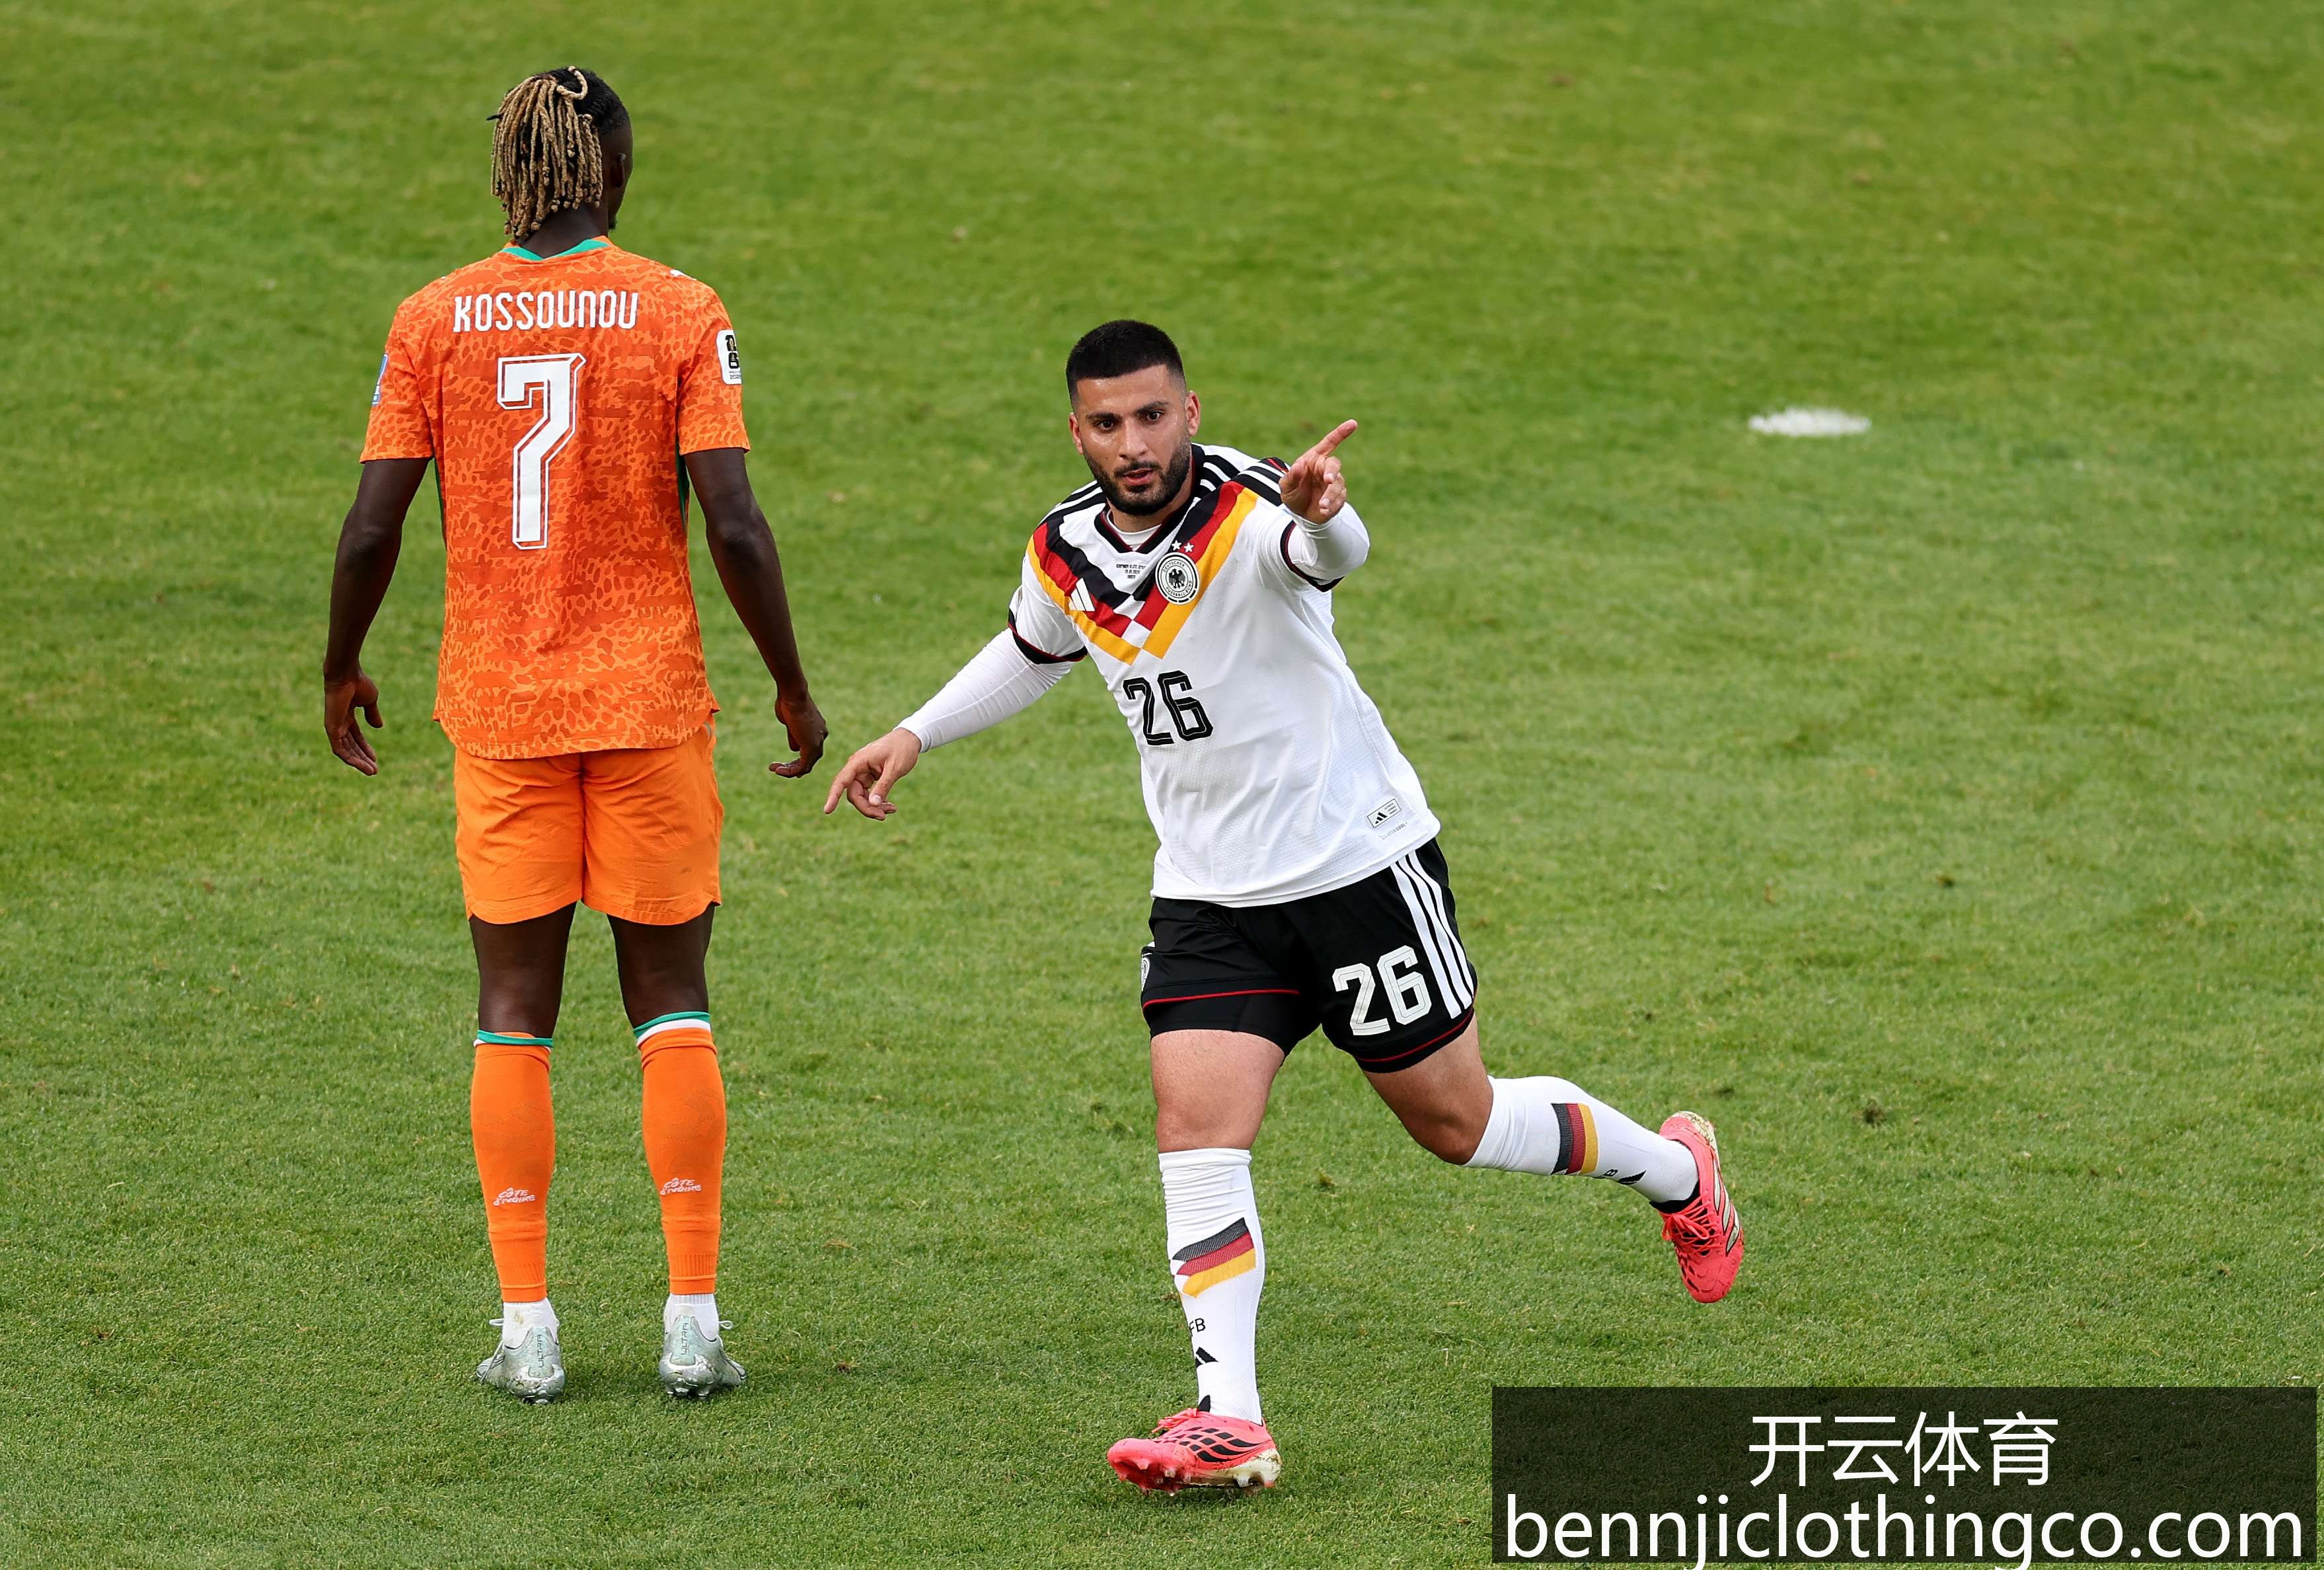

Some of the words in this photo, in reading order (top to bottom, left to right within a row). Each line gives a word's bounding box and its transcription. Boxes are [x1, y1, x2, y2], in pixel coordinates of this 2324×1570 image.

[453, 290, 639, 332] KOSSOUNOU
[497, 352, 587, 550] 7
[1123, 670, 1214, 746] 26
[1332, 946, 1431, 1036] 26
